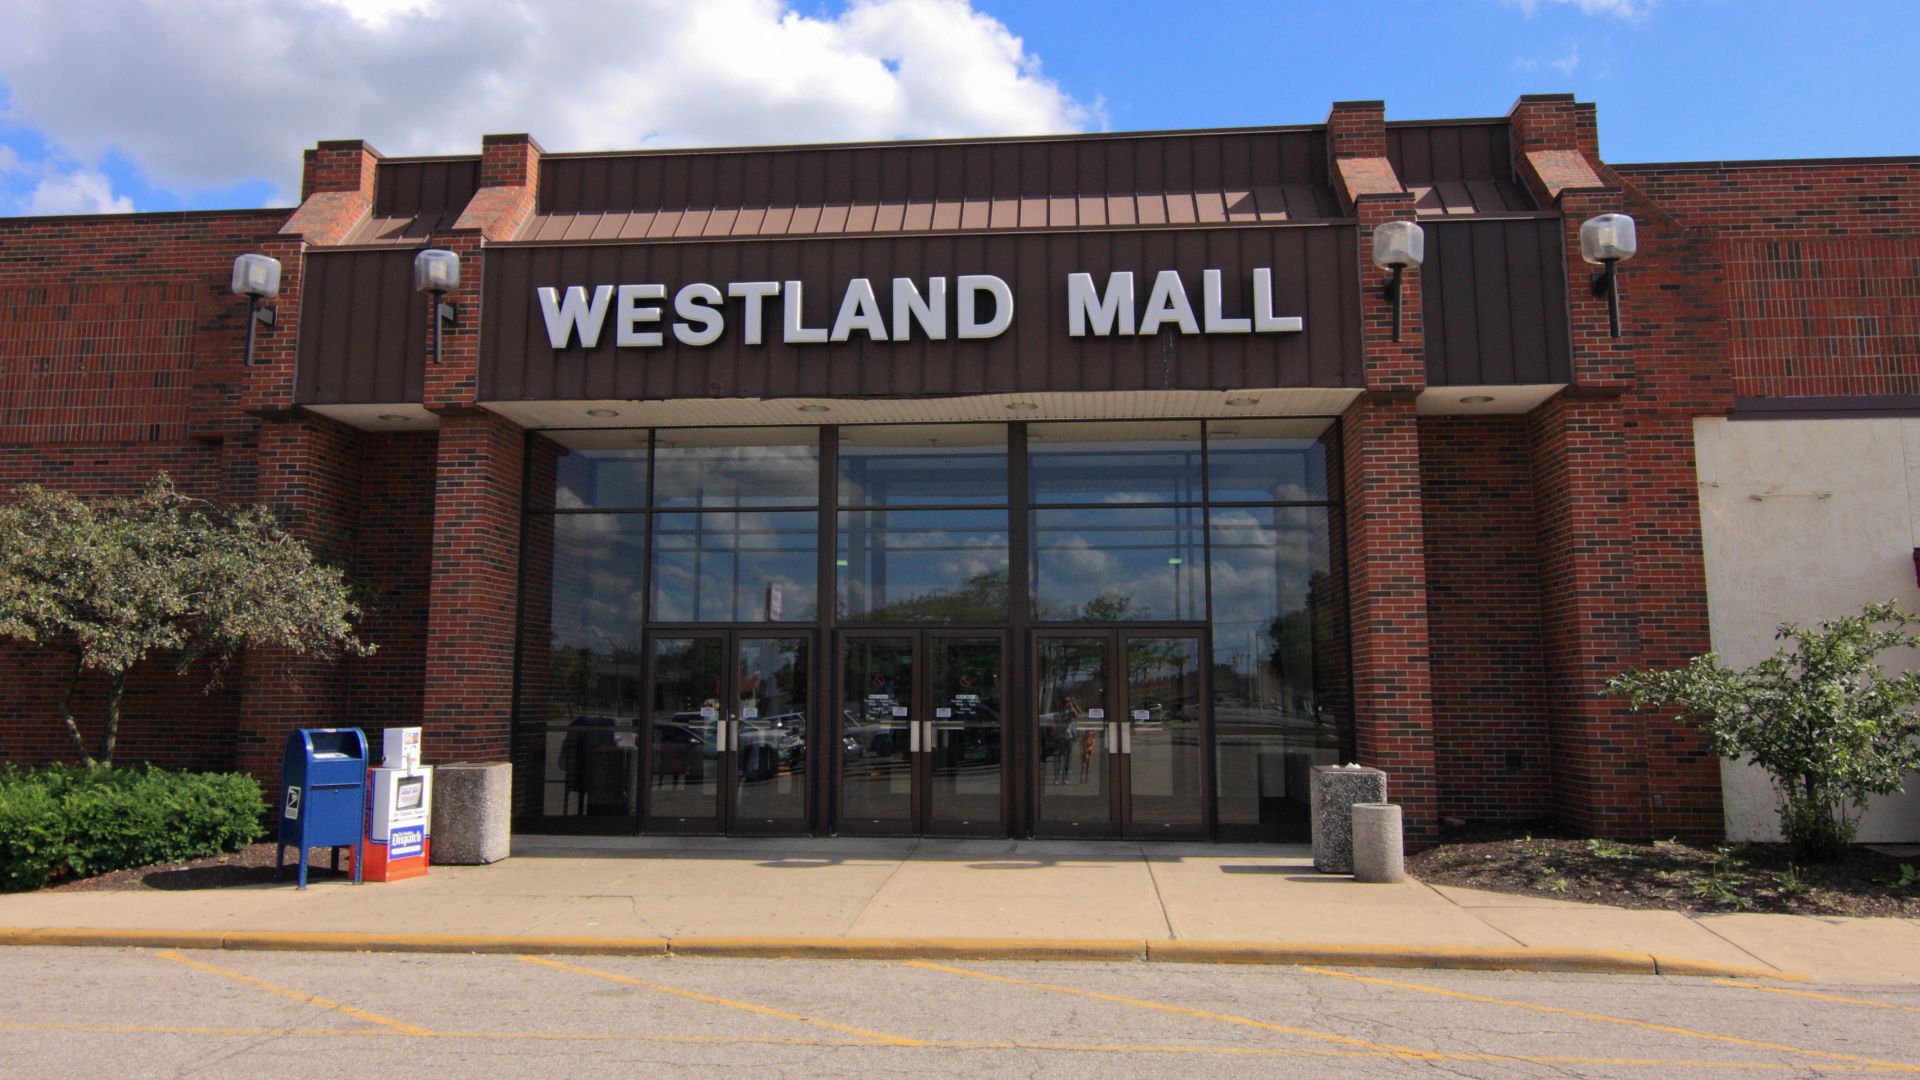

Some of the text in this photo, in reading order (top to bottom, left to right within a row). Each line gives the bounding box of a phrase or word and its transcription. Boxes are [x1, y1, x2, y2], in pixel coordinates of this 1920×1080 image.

[537, 267, 1303, 349] WESTLAND MALL
[392, 831, 421, 846] Dispatch
